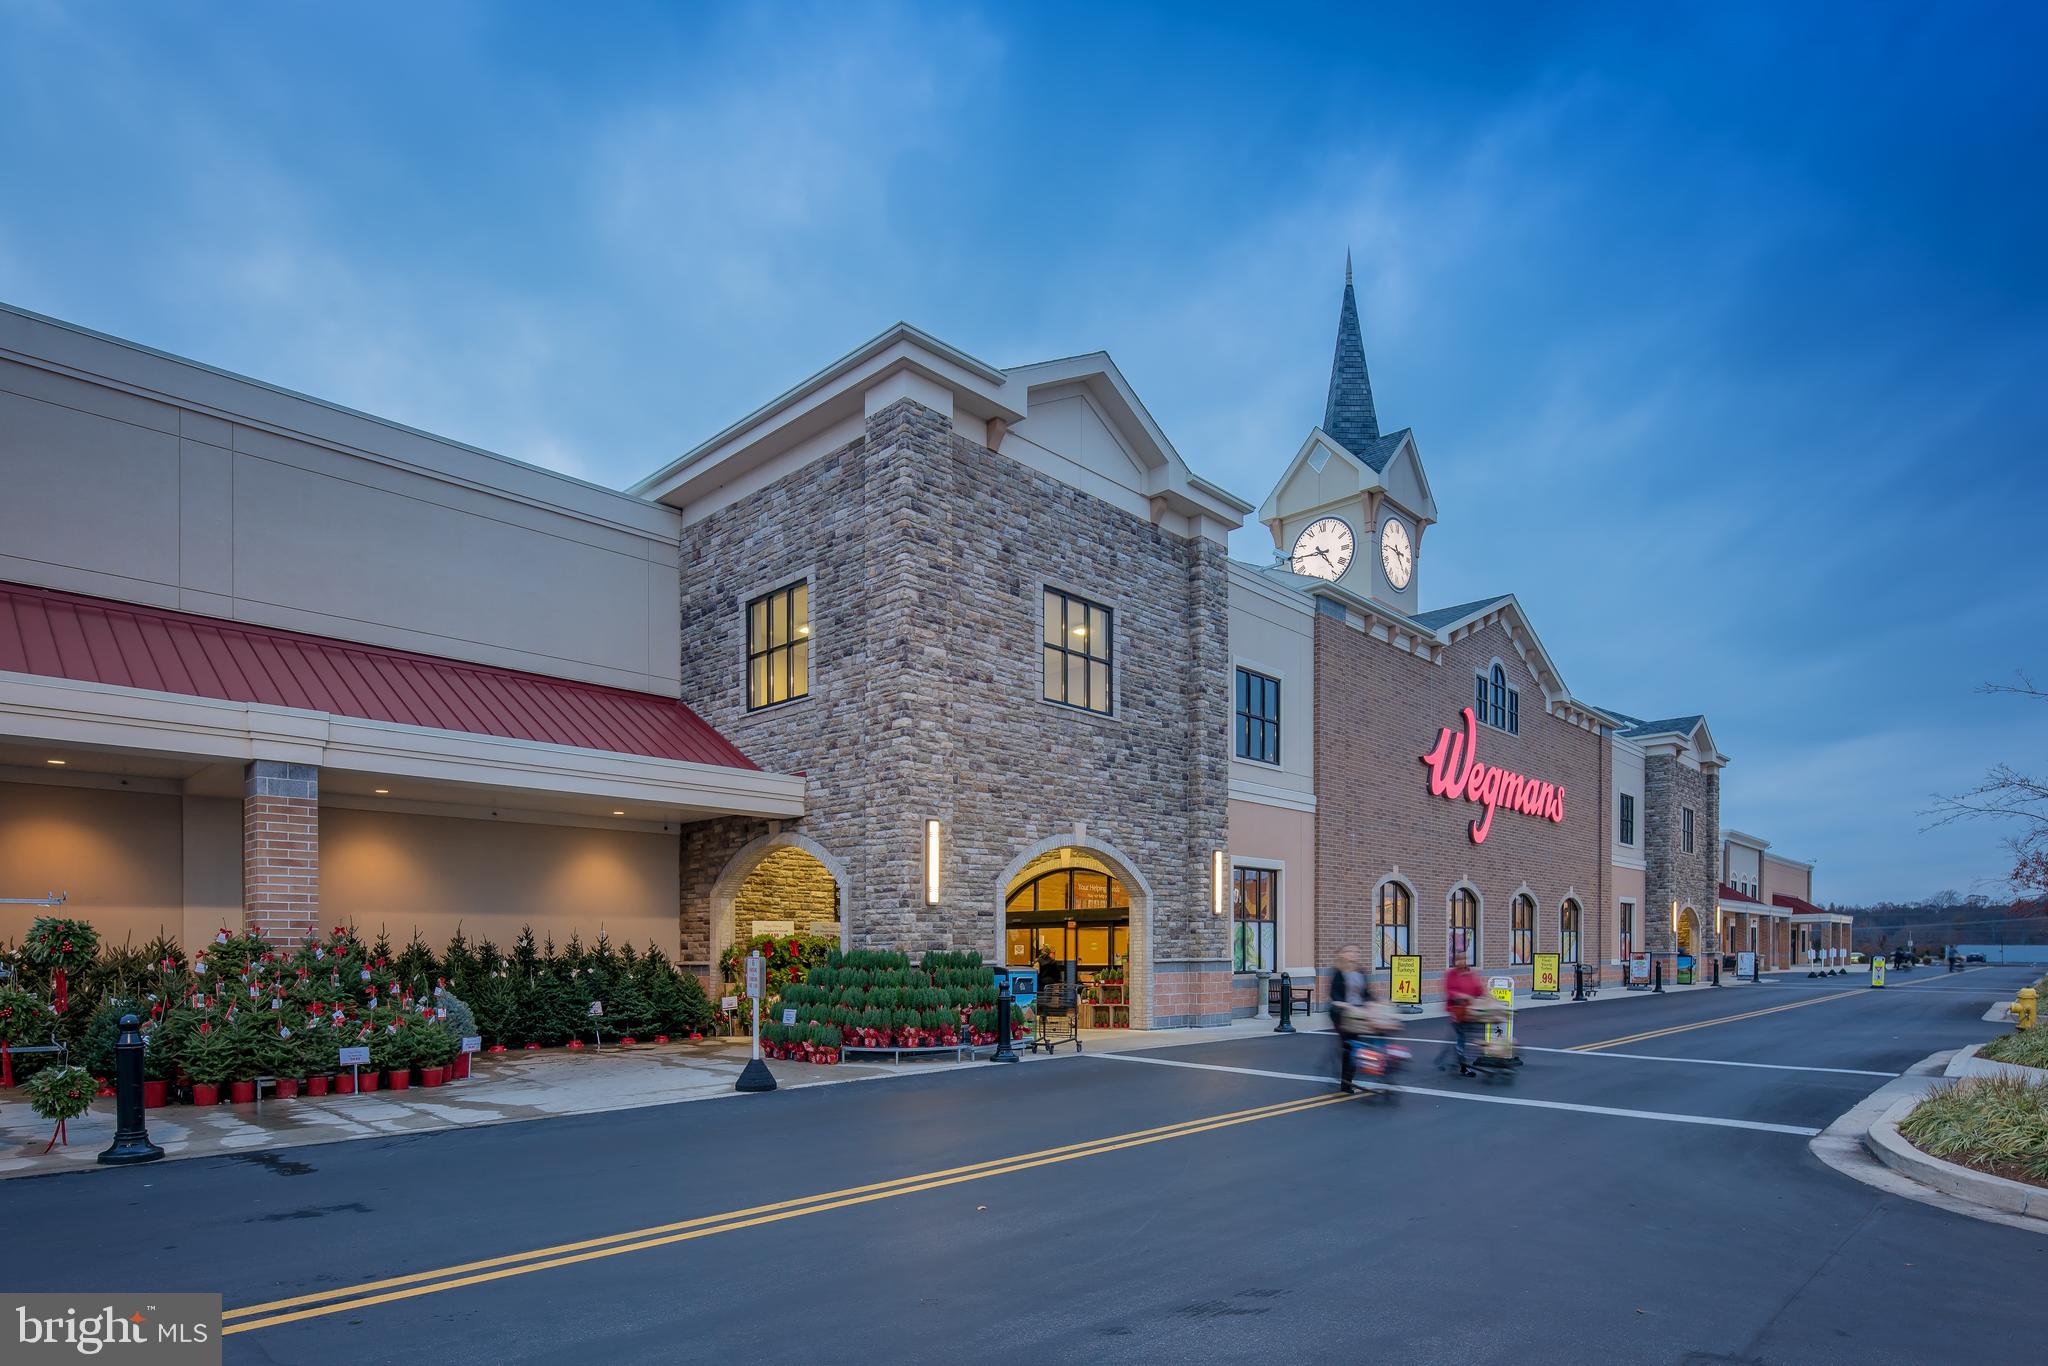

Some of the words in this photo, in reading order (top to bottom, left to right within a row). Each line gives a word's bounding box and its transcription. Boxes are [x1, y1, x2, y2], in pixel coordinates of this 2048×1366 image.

[1420, 707, 1565, 844] Wegmans
[1078, 883, 1089, 891] Your
[1396, 980, 1411, 993] .47
